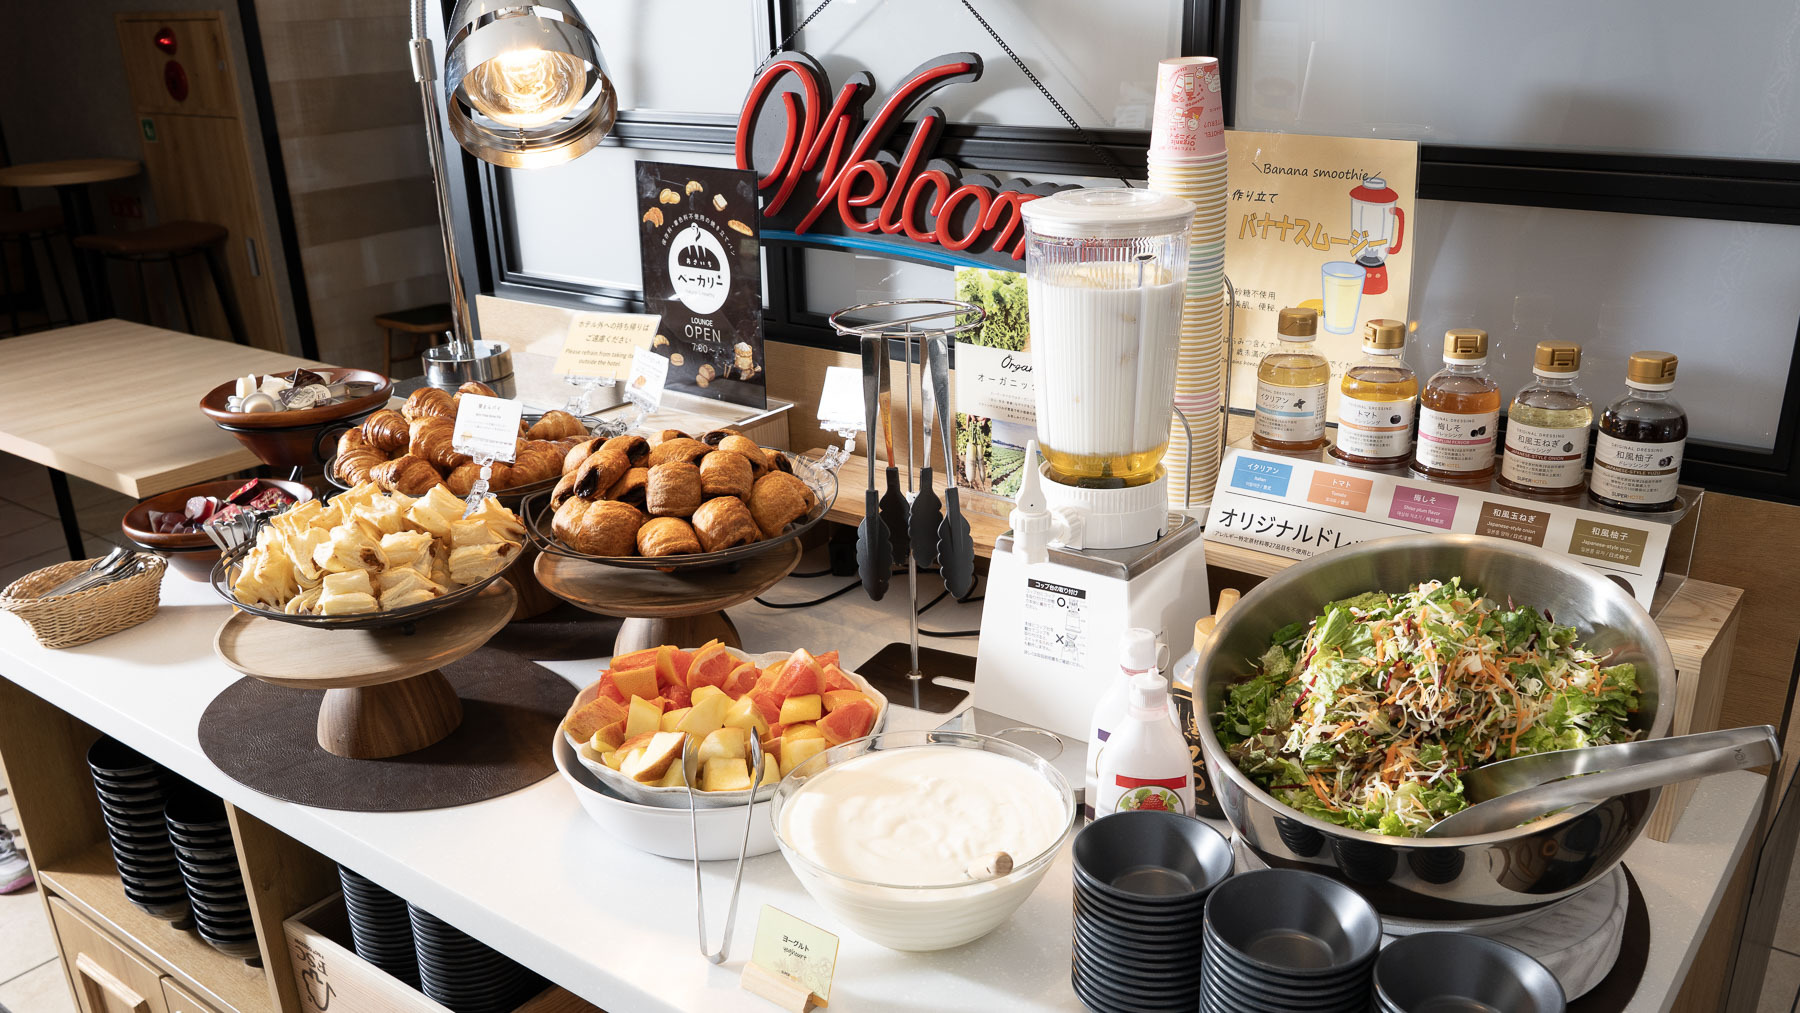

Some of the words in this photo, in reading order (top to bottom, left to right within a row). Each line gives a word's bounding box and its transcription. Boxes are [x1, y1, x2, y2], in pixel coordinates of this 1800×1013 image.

[735, 59, 1026, 261] Welcom
[1263, 163, 1309, 177] Banana
[1313, 167, 1370, 182] smoothie
[1231, 188, 1279, 204] 作り立て
[1238, 212, 1388, 257] バナナスムージー
[1234, 287, 1276, 301] 砂糖不使用
[690, 316, 714, 327] LOUNGE
[684, 324, 721, 343] OPEN
[1260, 393, 1289, 404] イタリアン
[1358, 411, 1377, 419] トマト
[1437, 423, 1461, 433] 梅しそ
[1518, 434, 1561, 449] 和風玉ねぎ
[1616, 450, 1653, 463] 和風柚子
[1247, 462, 1280, 475] イタリアン
[1618, 460, 1650, 469] ドレッシング
[1332, 478, 1351, 488] トマト
[1413, 493, 1437, 505] 梅しそ
[1492, 508, 1537, 524] 和風玉ねぎ
[1219, 508, 1365, 549] オリジナルドレ
[1486, 521, 1522, 533] Japanese-style
[1591, 526, 1629, 541] 和風柚子
[1581, 539, 1619, 551] Japanese-style
[1619, 546, 1633, 554] yuzu
[294, 944, 329, 977] FSC
